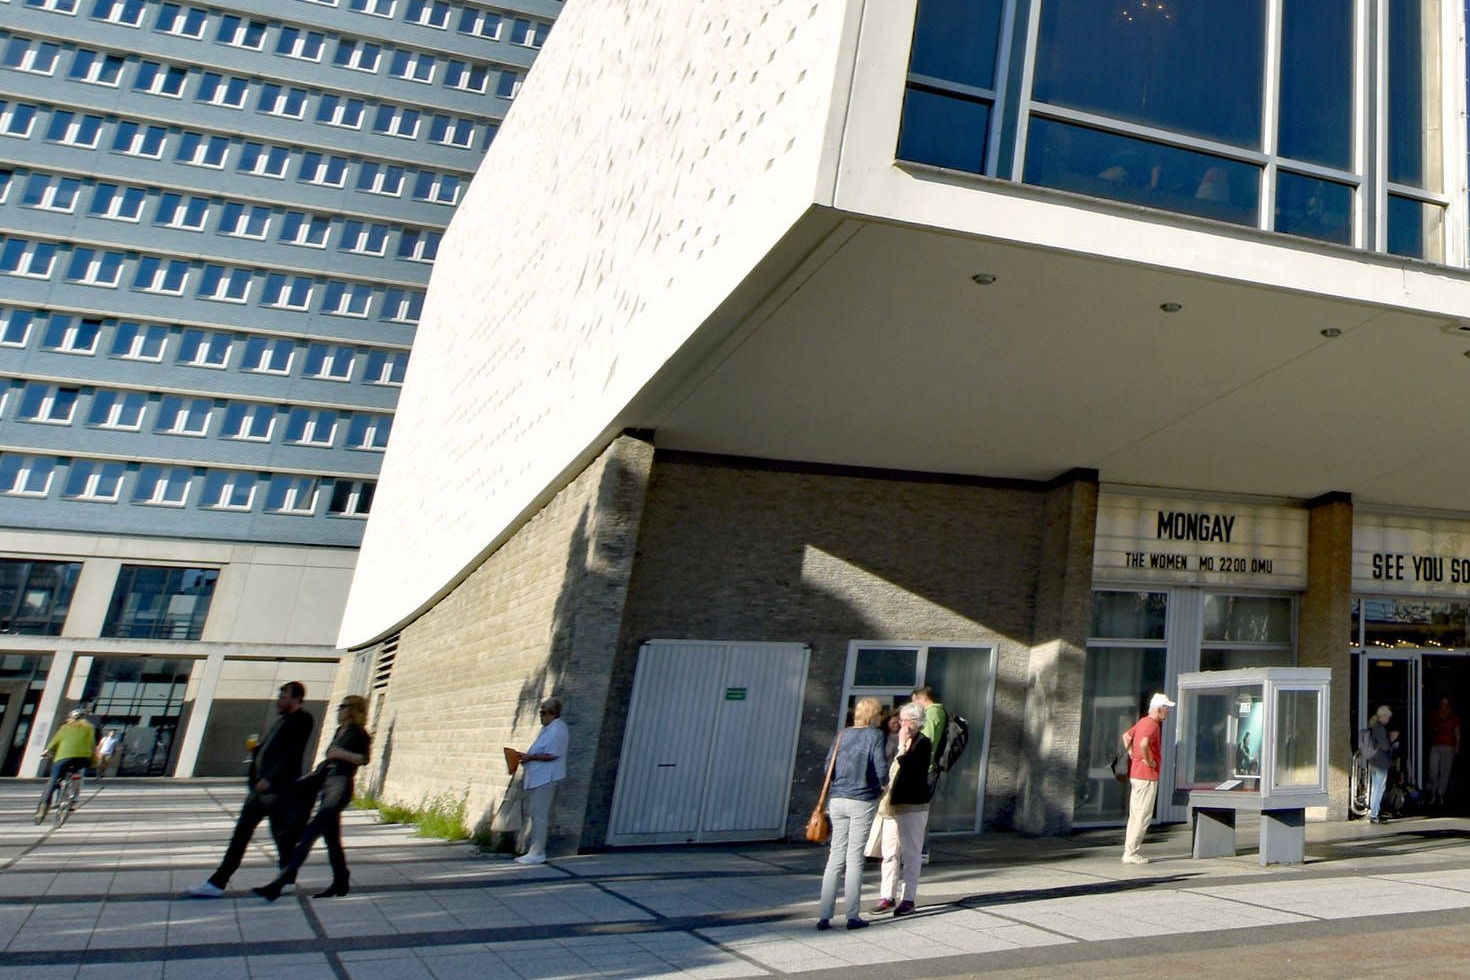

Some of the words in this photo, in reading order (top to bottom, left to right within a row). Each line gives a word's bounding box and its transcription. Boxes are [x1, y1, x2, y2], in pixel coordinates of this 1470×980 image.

[1157, 510, 1235, 543] MONGAY
[1125, 552, 1145, 568] THE
[1150, 553, 1187, 570] WOMEN
[1200, 556, 1214, 571] MO
[1219, 557, 1246, 572] 2200
[1251, 558, 1273, 574] OMU
[1372, 553, 1404, 581] SEE
[1413, 555, 1443, 582] YOU
